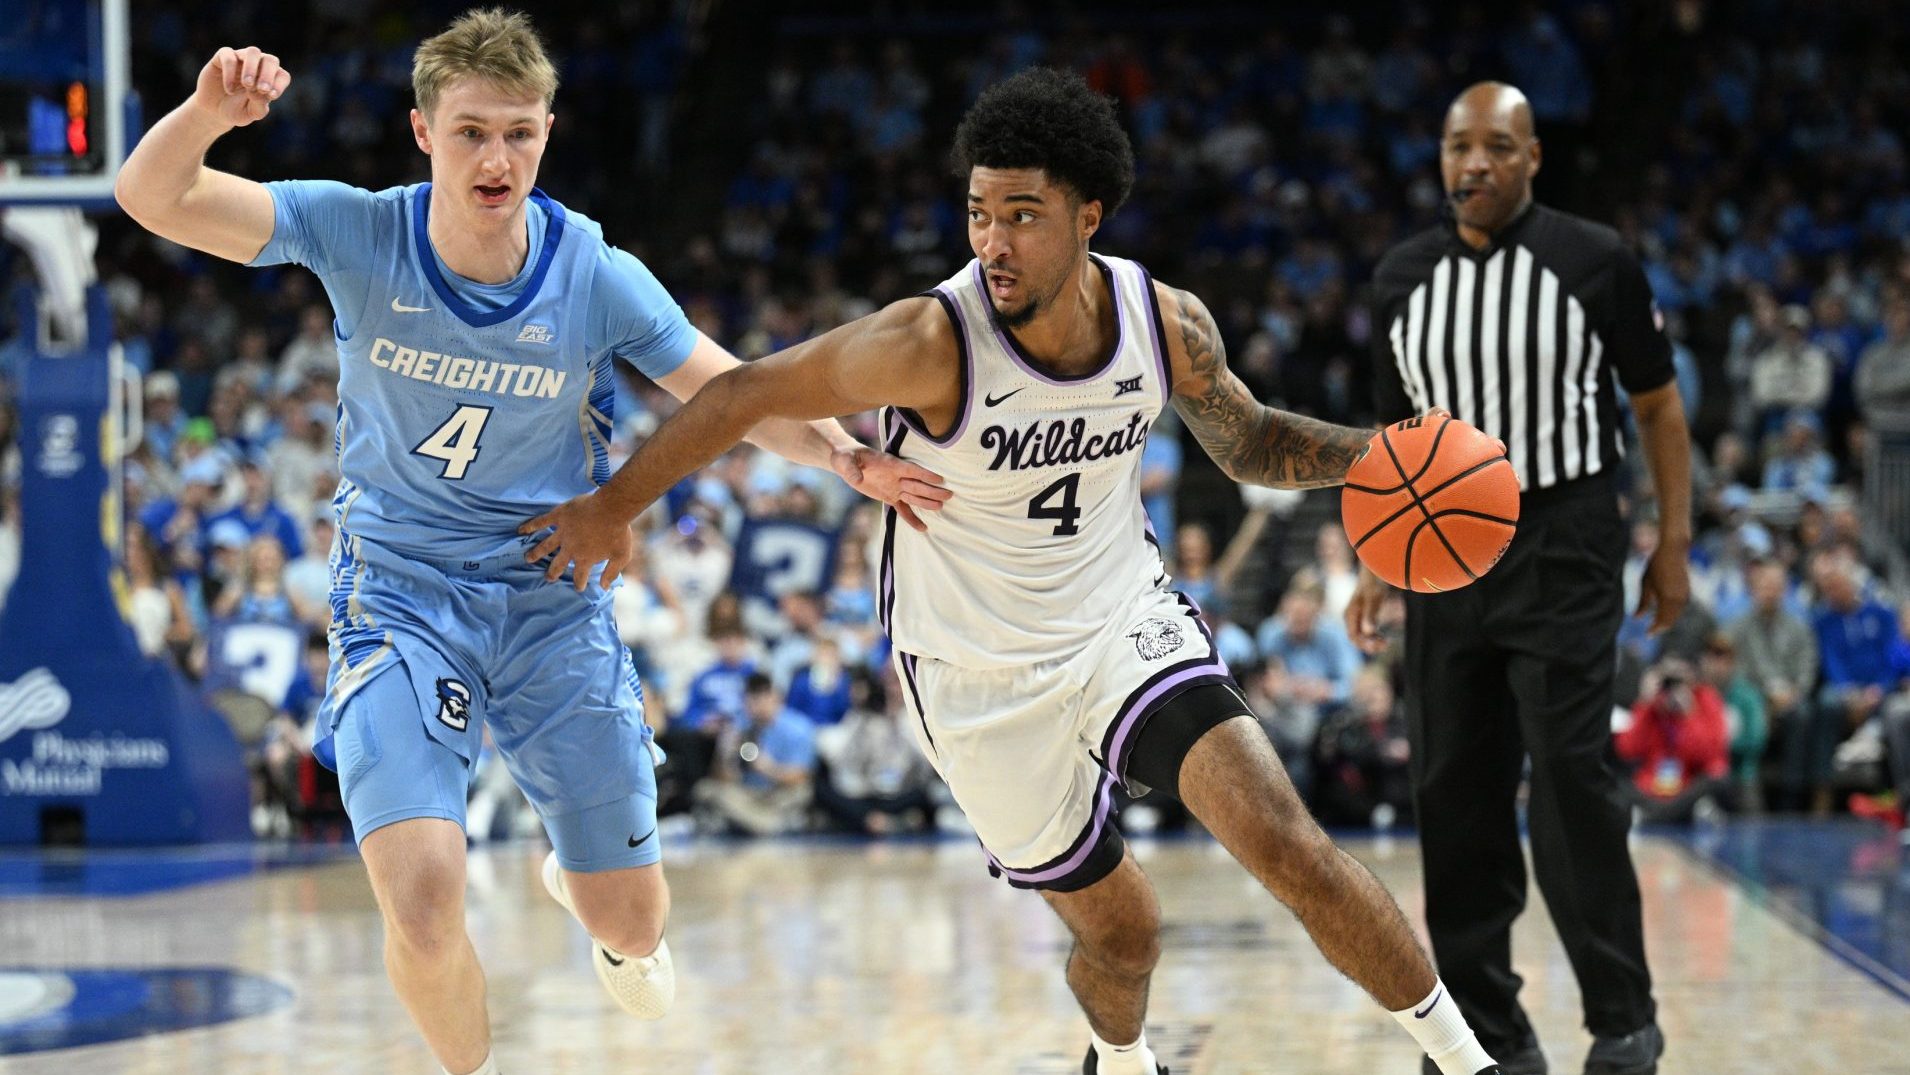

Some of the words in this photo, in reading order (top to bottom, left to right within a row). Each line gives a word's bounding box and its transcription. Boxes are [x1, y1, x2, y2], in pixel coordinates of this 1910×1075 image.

[517, 331, 554, 342] EAST
[523, 325, 549, 334] BIG
[369, 338, 567, 399] CREIGHTON
[409, 403, 494, 480] 4
[980, 410, 1150, 470] Wildcats
[1027, 473, 1081, 536] 4
